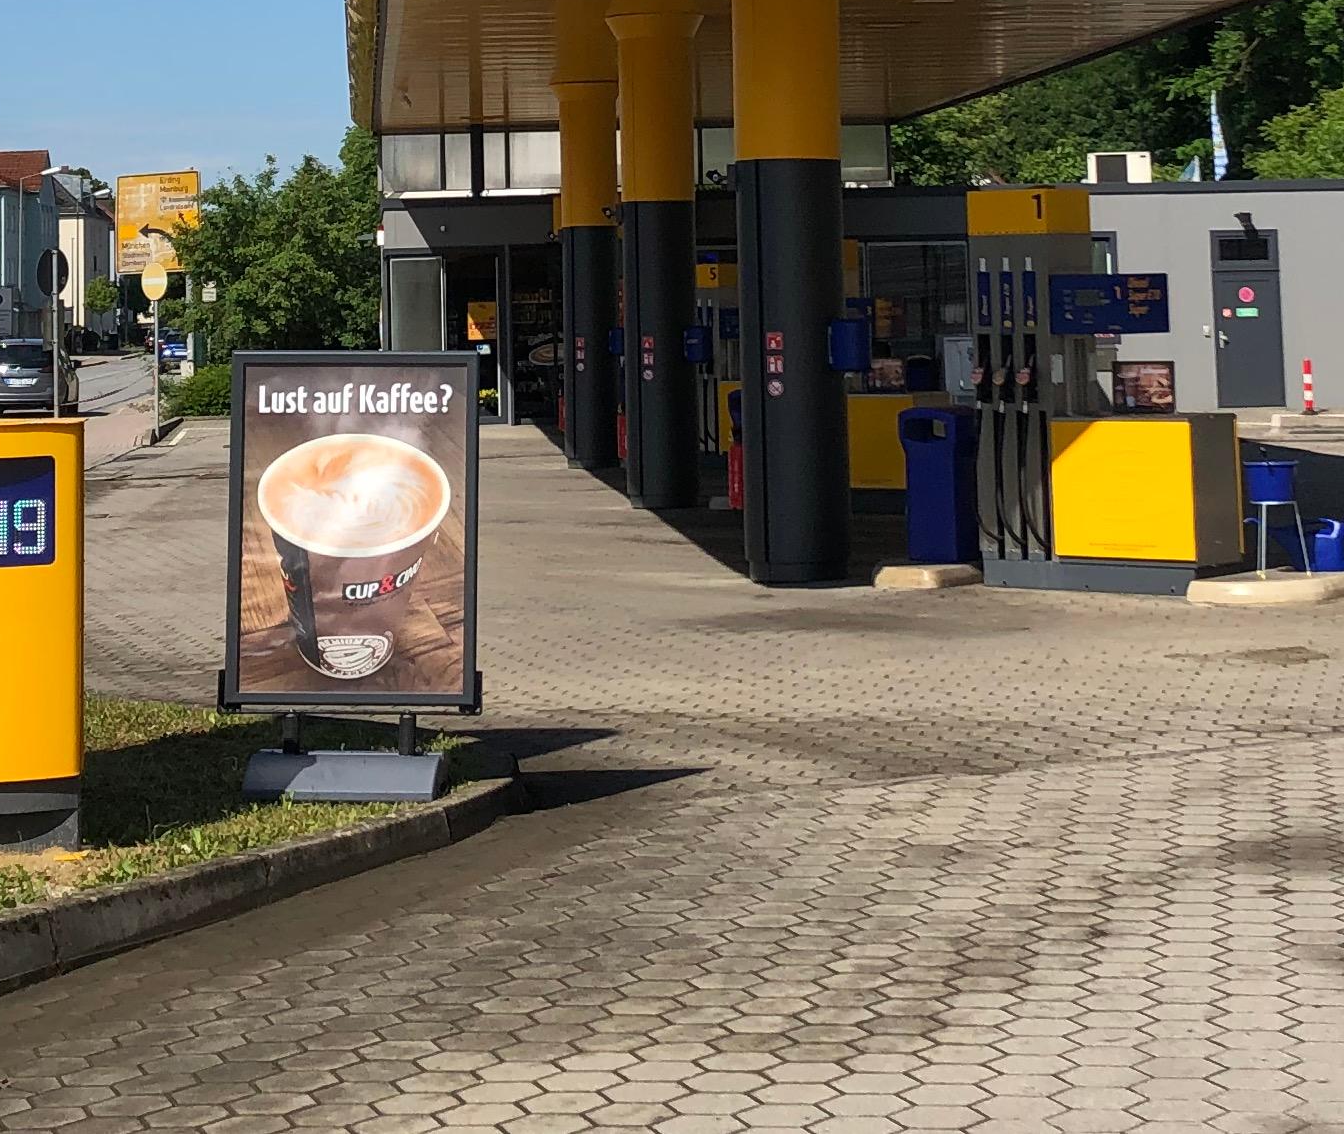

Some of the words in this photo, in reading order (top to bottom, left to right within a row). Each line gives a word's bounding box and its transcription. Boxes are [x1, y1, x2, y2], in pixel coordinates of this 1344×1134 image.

[1031, 193, 1042, 220] 1
[709, 267, 717, 281] 5
[258, 385, 308, 414] Lust
[312, 382, 354, 414] auf
[359, 382, 454, 414] Kaffee?
